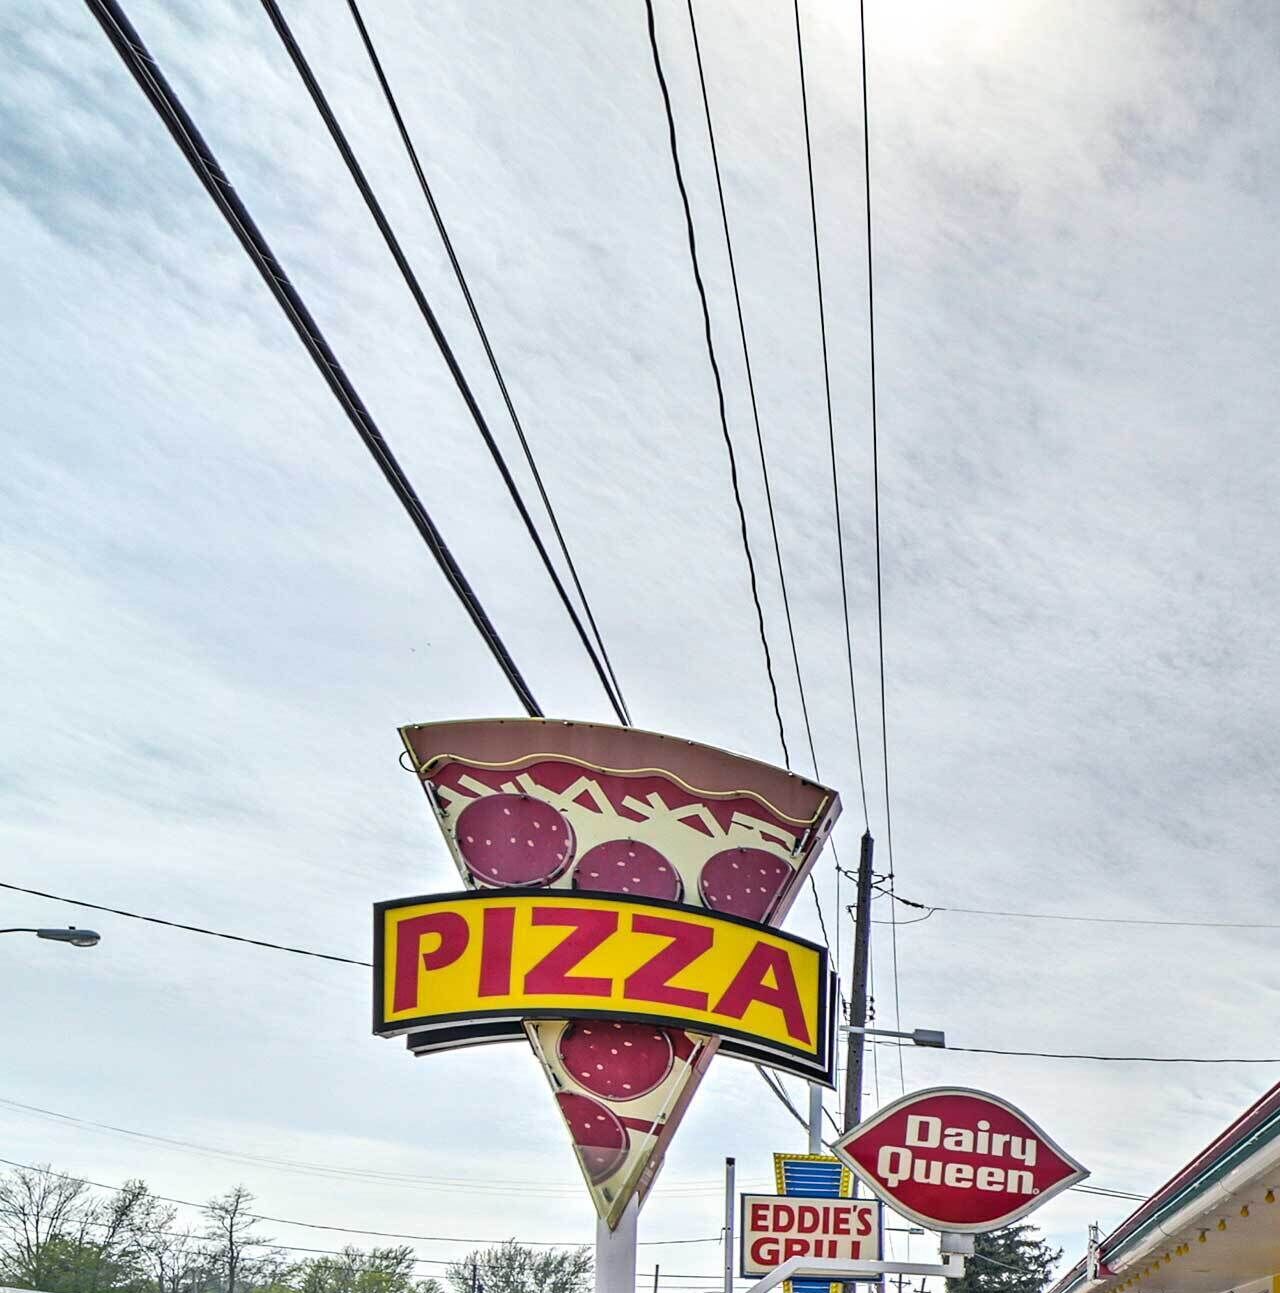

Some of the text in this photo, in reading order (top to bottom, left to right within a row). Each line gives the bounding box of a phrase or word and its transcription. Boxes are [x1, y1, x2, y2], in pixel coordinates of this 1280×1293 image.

[393, 906, 812, 1046] PIZZA
[905, 1114, 1038, 1167] Dairy
[877, 1145, 1034, 1194] Queen
[751, 1204, 872, 1236] EDDIE'S
